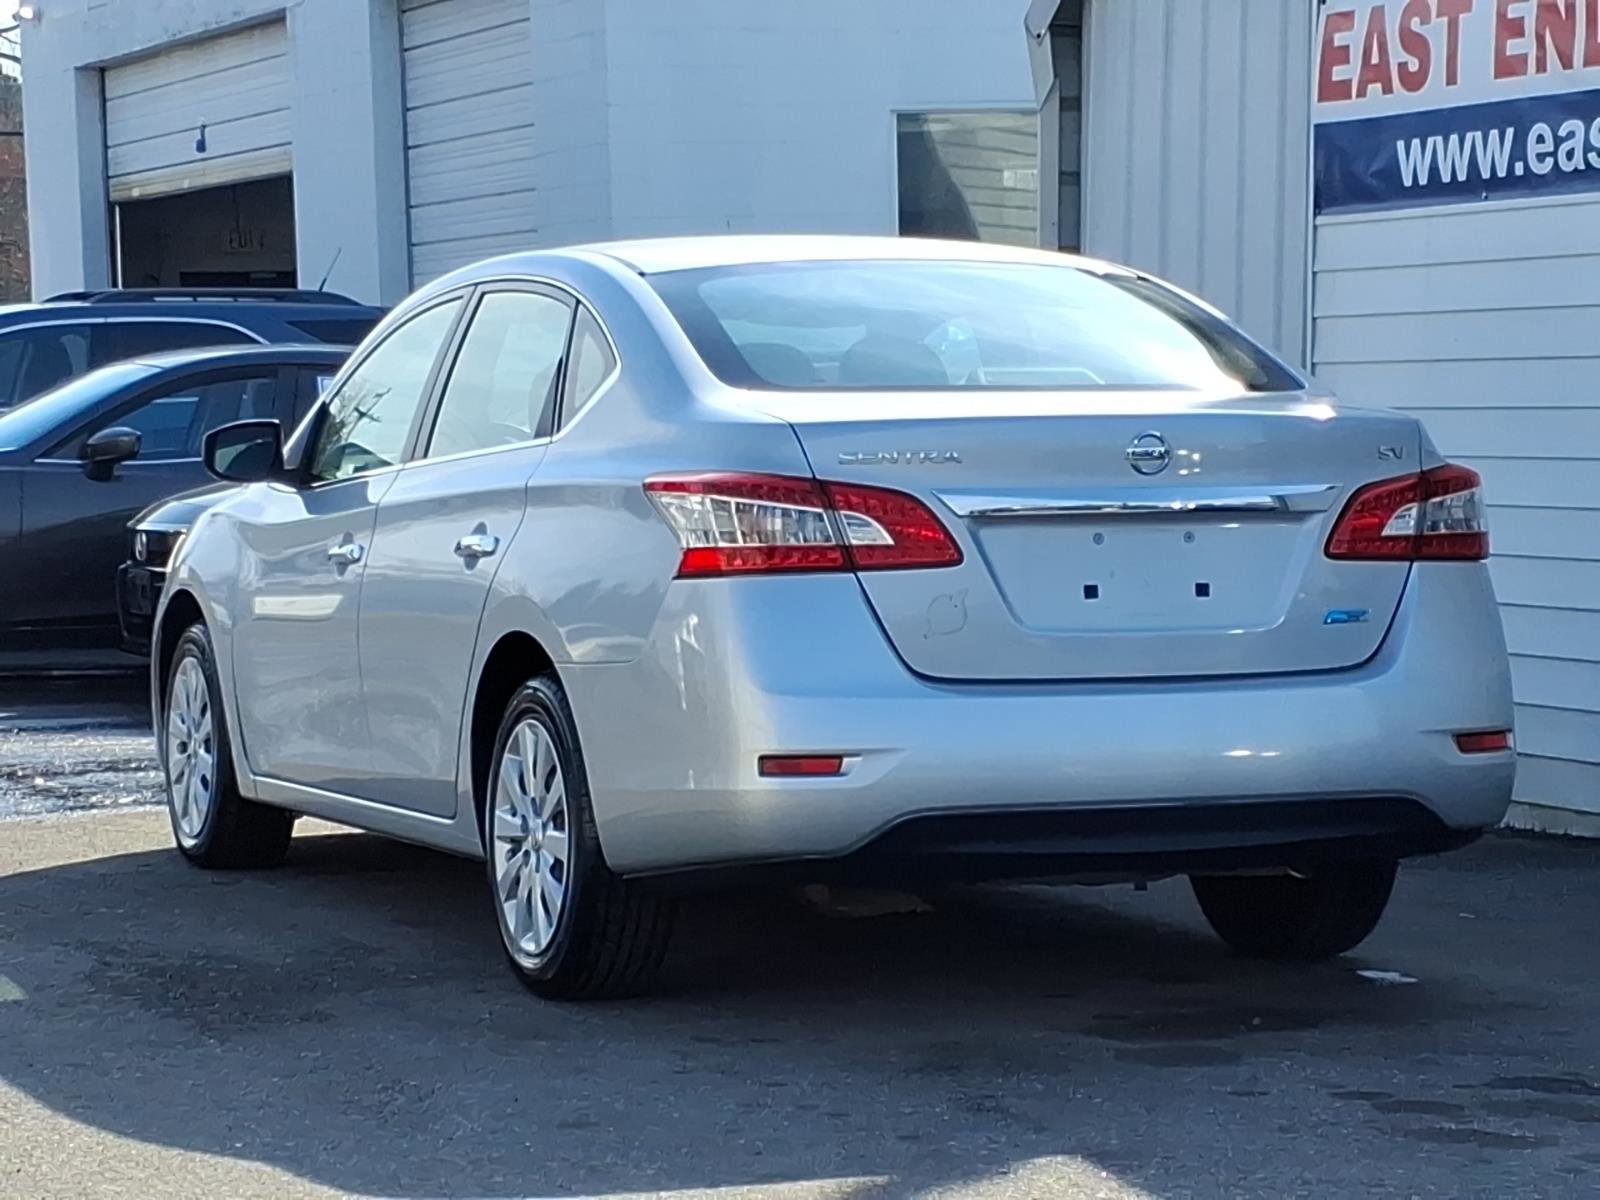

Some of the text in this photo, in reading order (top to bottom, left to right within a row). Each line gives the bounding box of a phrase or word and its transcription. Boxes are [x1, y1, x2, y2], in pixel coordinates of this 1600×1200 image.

[1317, 0, 1473, 103] EAST
[838, 449, 963, 465] SENTRA
[1377, 445, 1404, 461] SV
